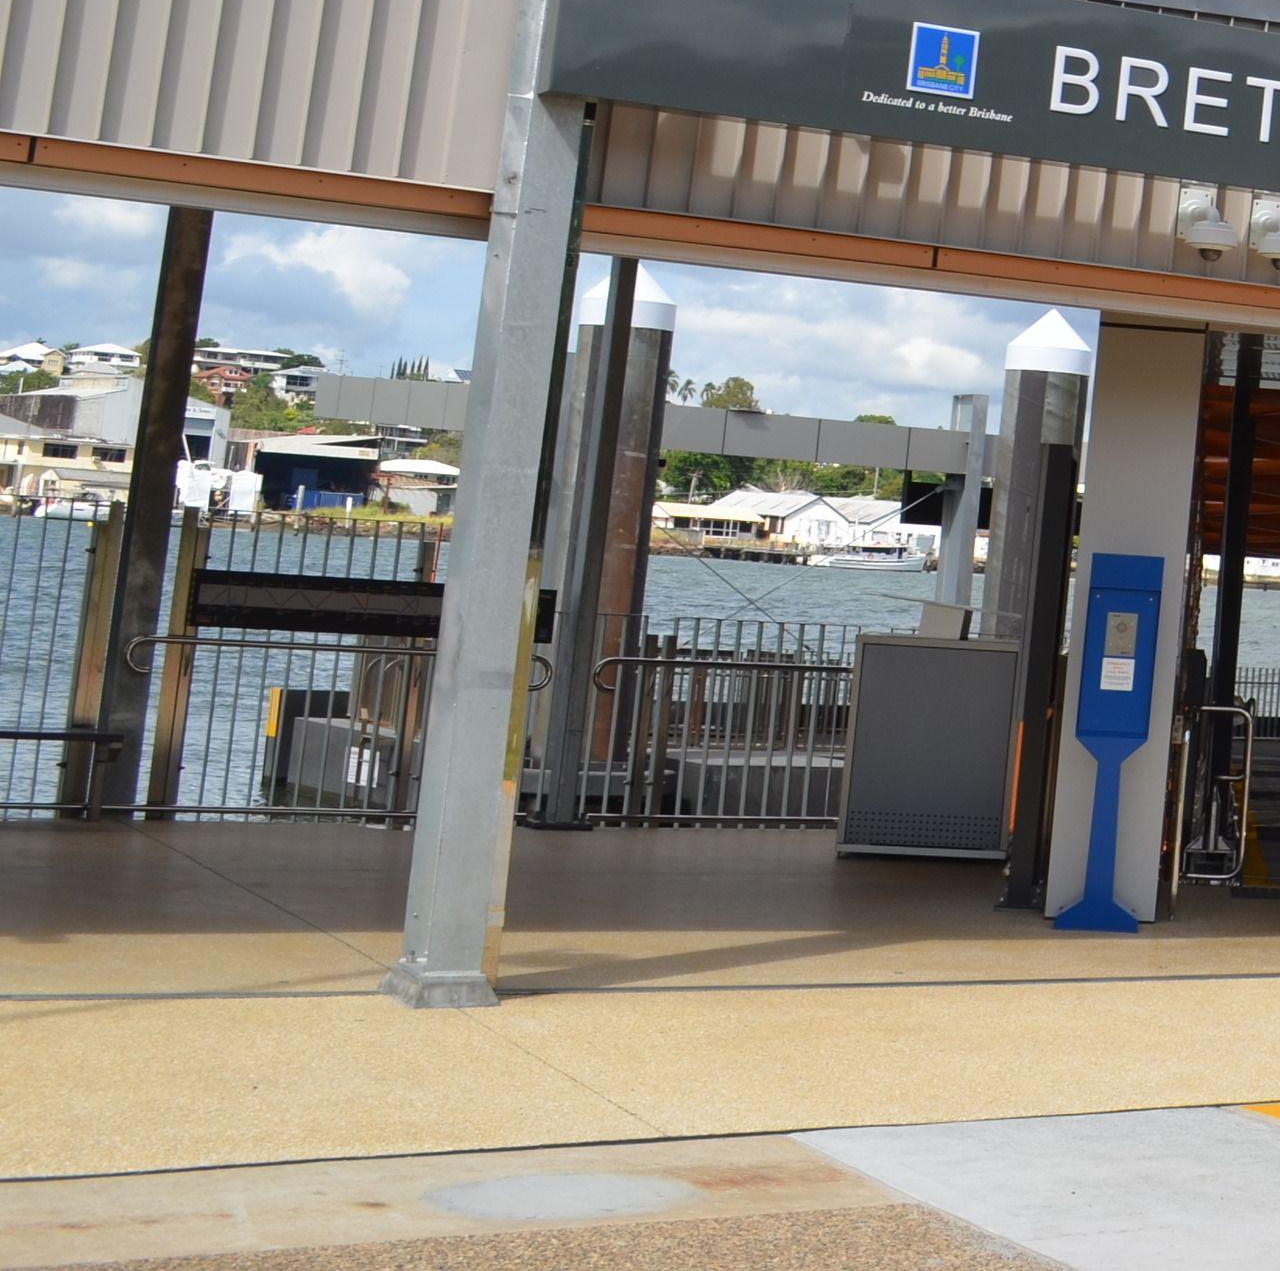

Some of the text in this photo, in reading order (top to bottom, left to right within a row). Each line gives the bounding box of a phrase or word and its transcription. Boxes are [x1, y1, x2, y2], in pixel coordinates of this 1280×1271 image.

[916, 79, 948, 90] BRISBANE
[861, 90, 1014, 123] Dedicated to a better Brisbane
